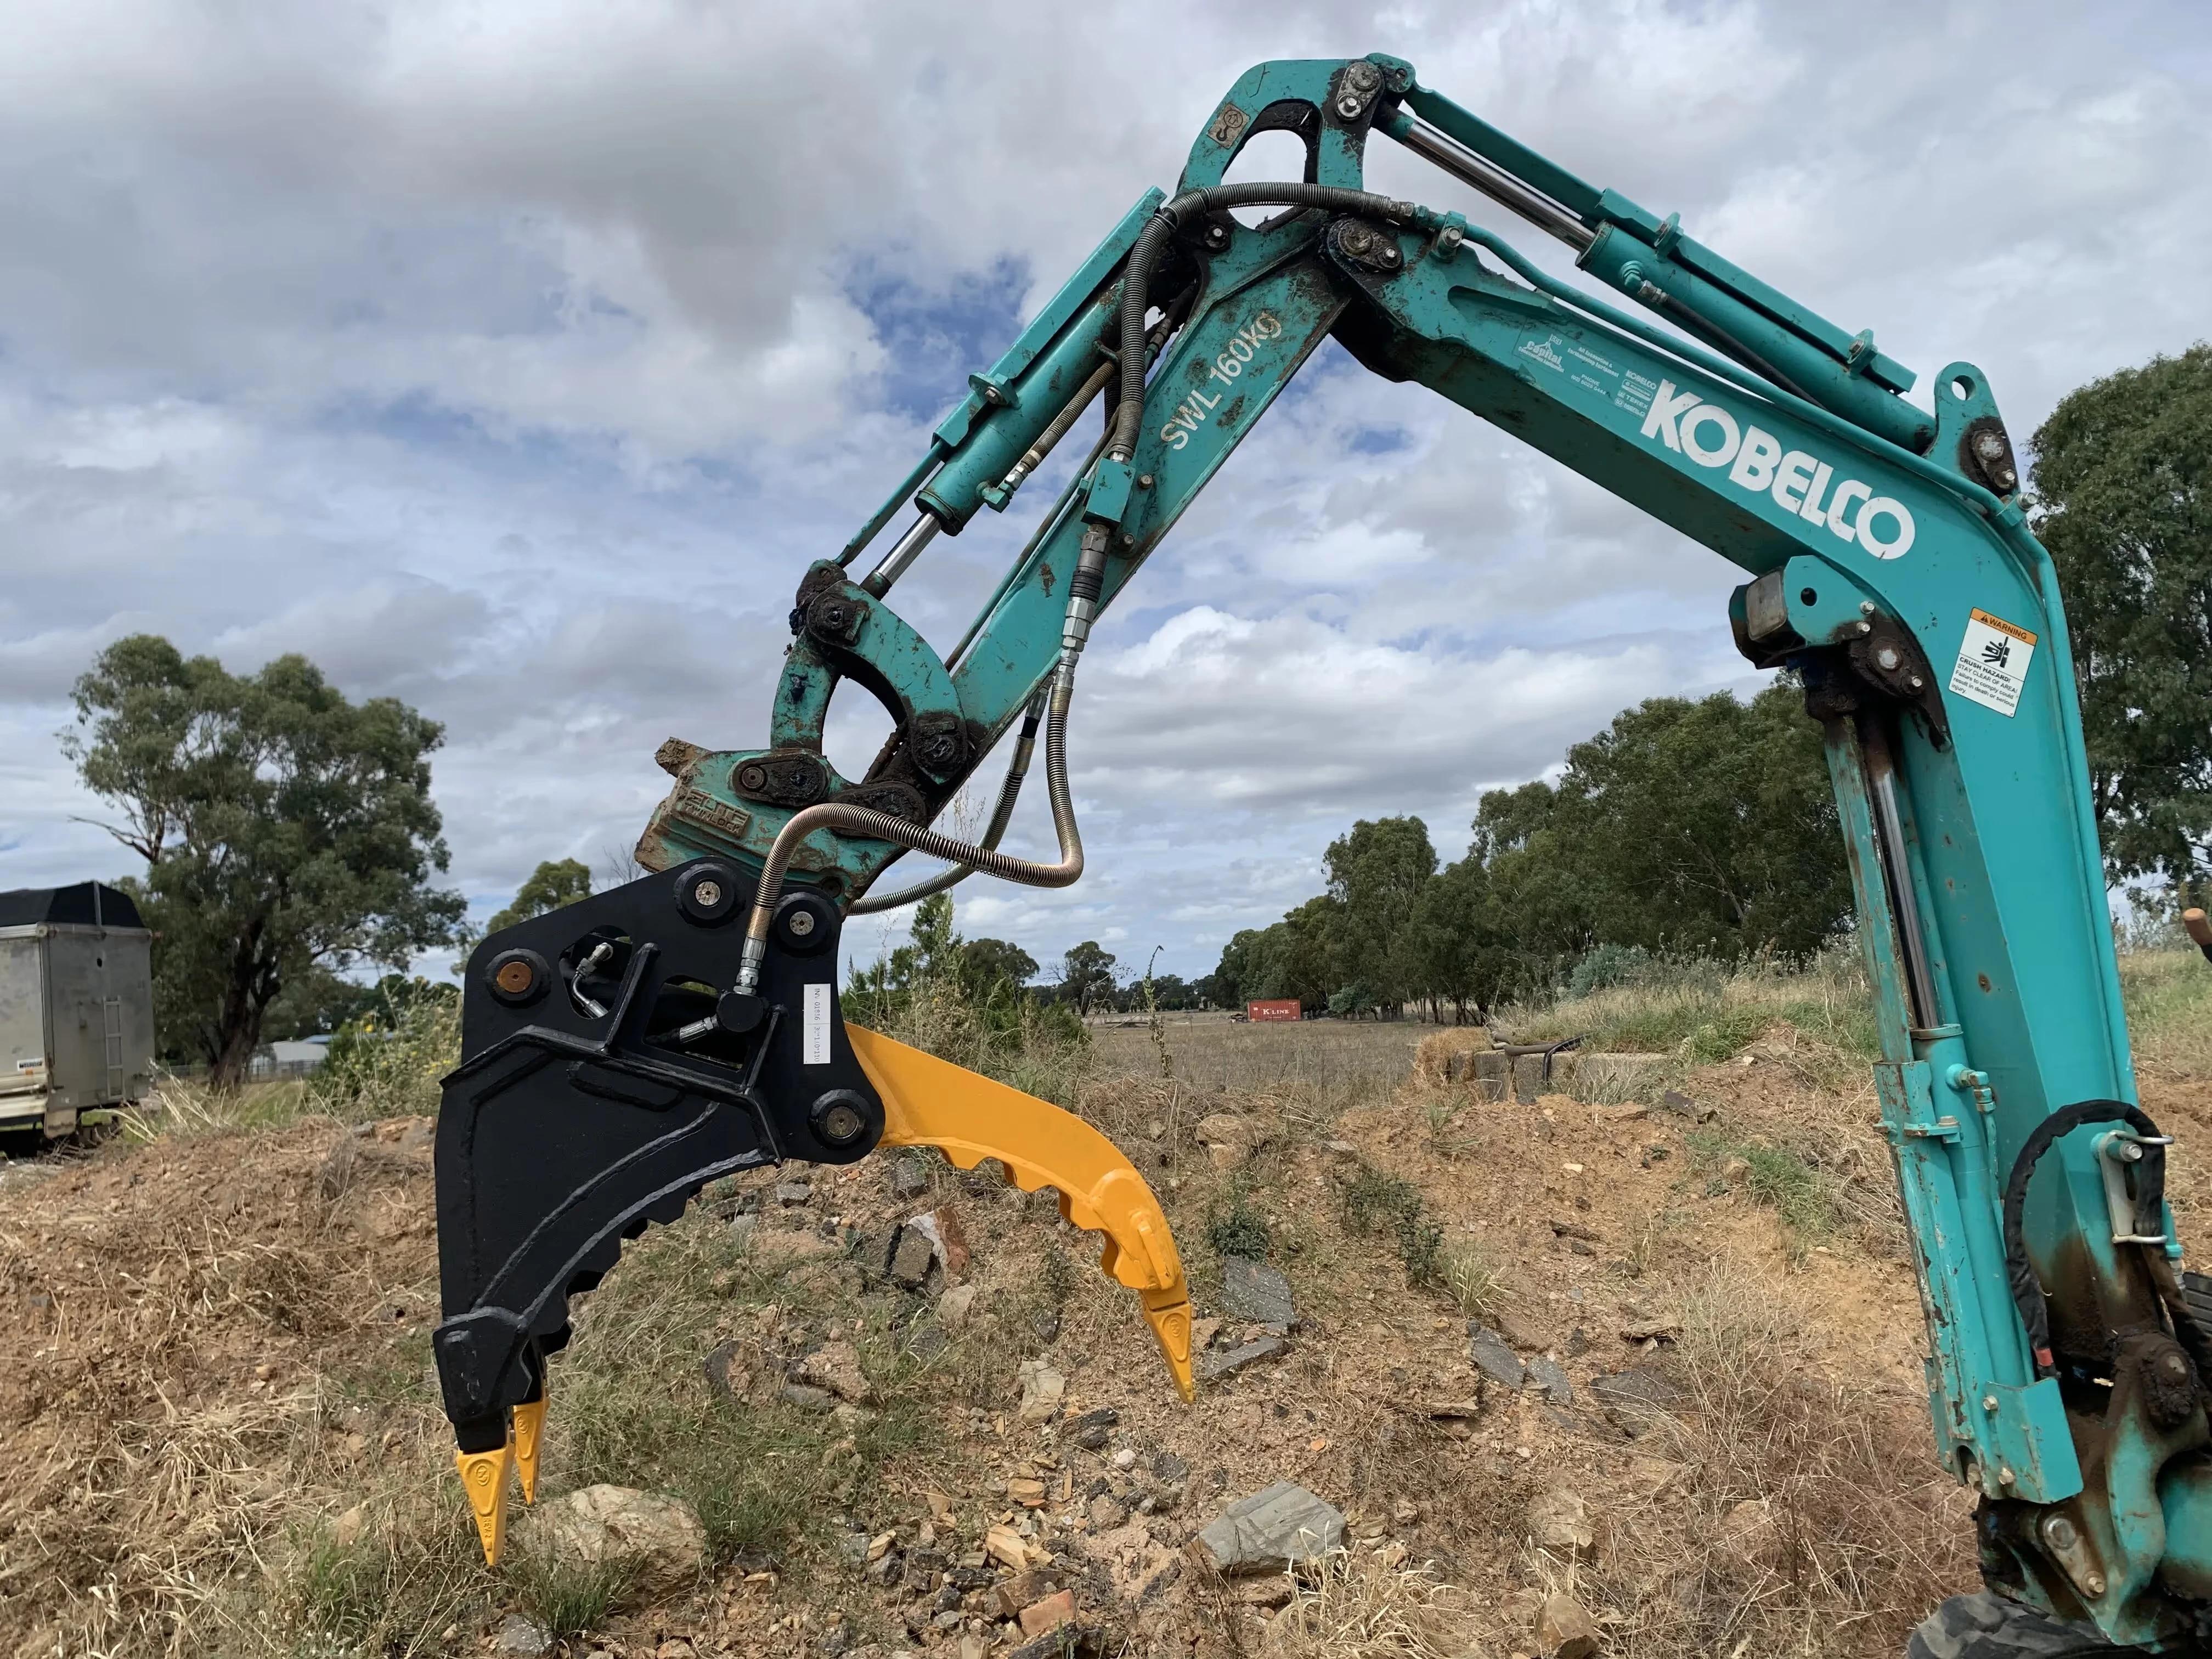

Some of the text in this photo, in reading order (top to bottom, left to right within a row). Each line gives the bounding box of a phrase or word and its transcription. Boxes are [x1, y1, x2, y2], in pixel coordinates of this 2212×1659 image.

[1527, 341, 1562, 364] Capital
[1160, 312, 1282, 450] SWL 160kg
[1582, 374, 1600, 387] PHONE
[1626, 369, 1657, 390] KOBELCO
[1626, 394, 1648, 410] TEREX
[1640, 379, 1915, 560] KOBELCO
[1989, 617, 2027, 640] WARNING
[1957, 663, 1972, 673] STAY
[1973, 669, 1991, 682] CLEAR
[2000, 682, 2018, 693] AREA!
[1960, 656, 2011, 683] CRUSH HAZARD!
[1951, 684, 1967, 694] injury.
[1953, 677, 1968, 687] result
[1974, 685, 1989, 696] death
[1996, 695, 2015, 708] serious
[1955, 670, 1972, 681] Failure
[1979, 680, 1999, 693] comply
[1999, 687, 2013, 699] could
